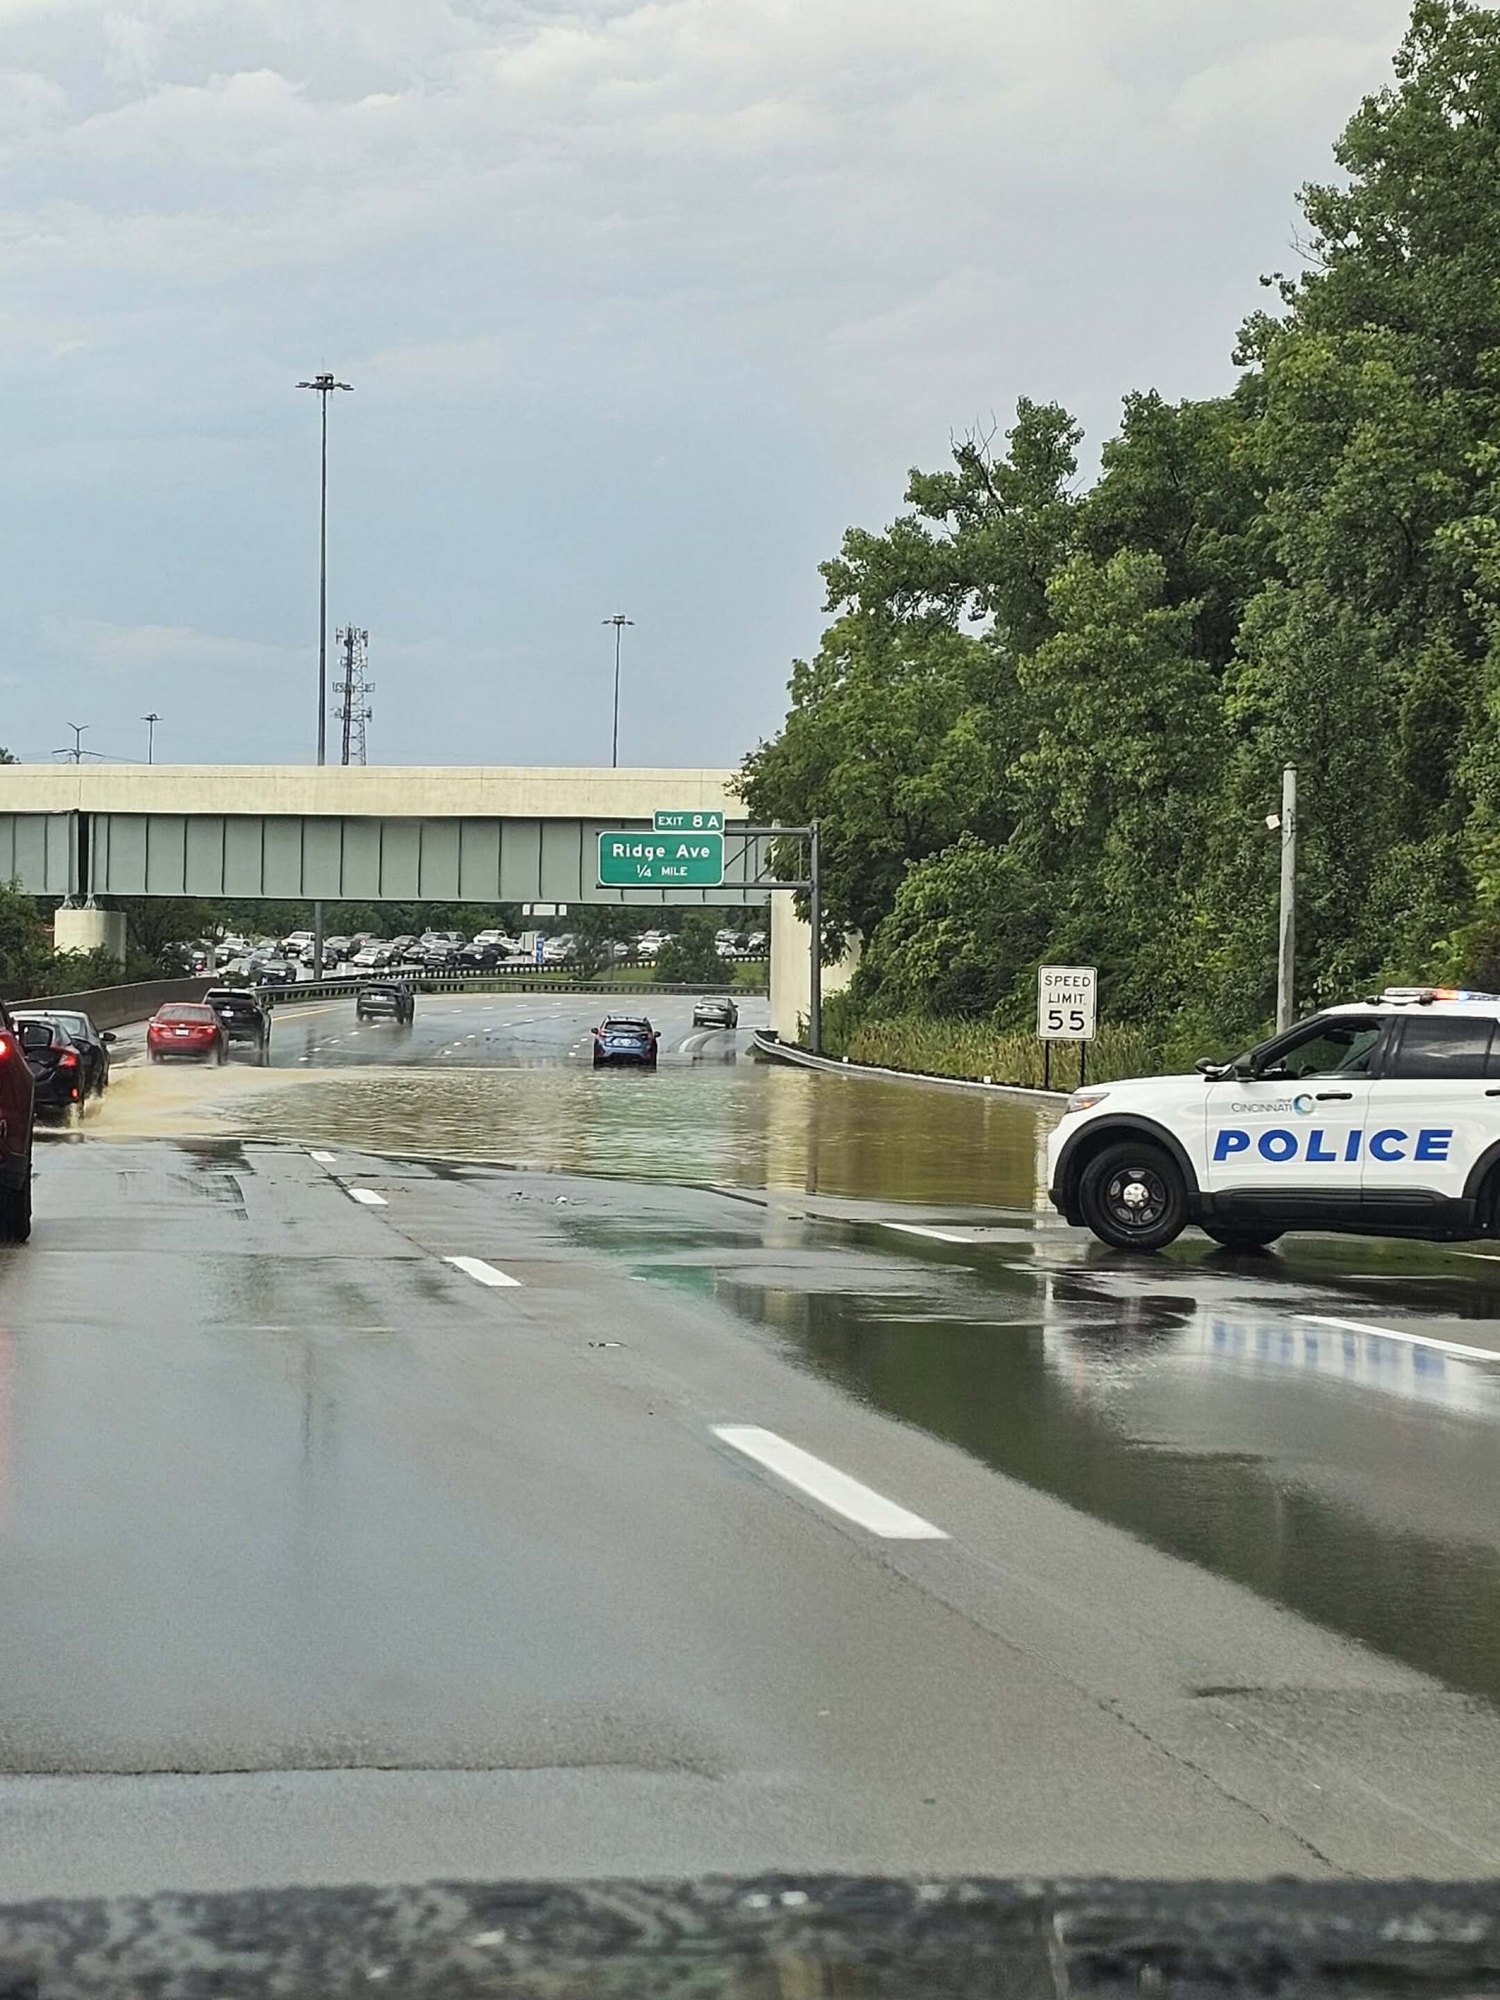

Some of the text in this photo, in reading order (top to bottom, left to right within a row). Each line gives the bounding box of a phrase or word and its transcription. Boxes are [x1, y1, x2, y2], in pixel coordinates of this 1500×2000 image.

[657, 816, 684, 826] EXIT
[612, 843, 710, 861] Ridge Ave
[661, 866, 688, 876] MILE
[1044, 975, 1091, 988] SPEED
[1048, 993, 1085, 1004] LIMIT
[1048, 1010, 1085, 1031] 55
[1212, 1129, 1454, 1162] POLICE
